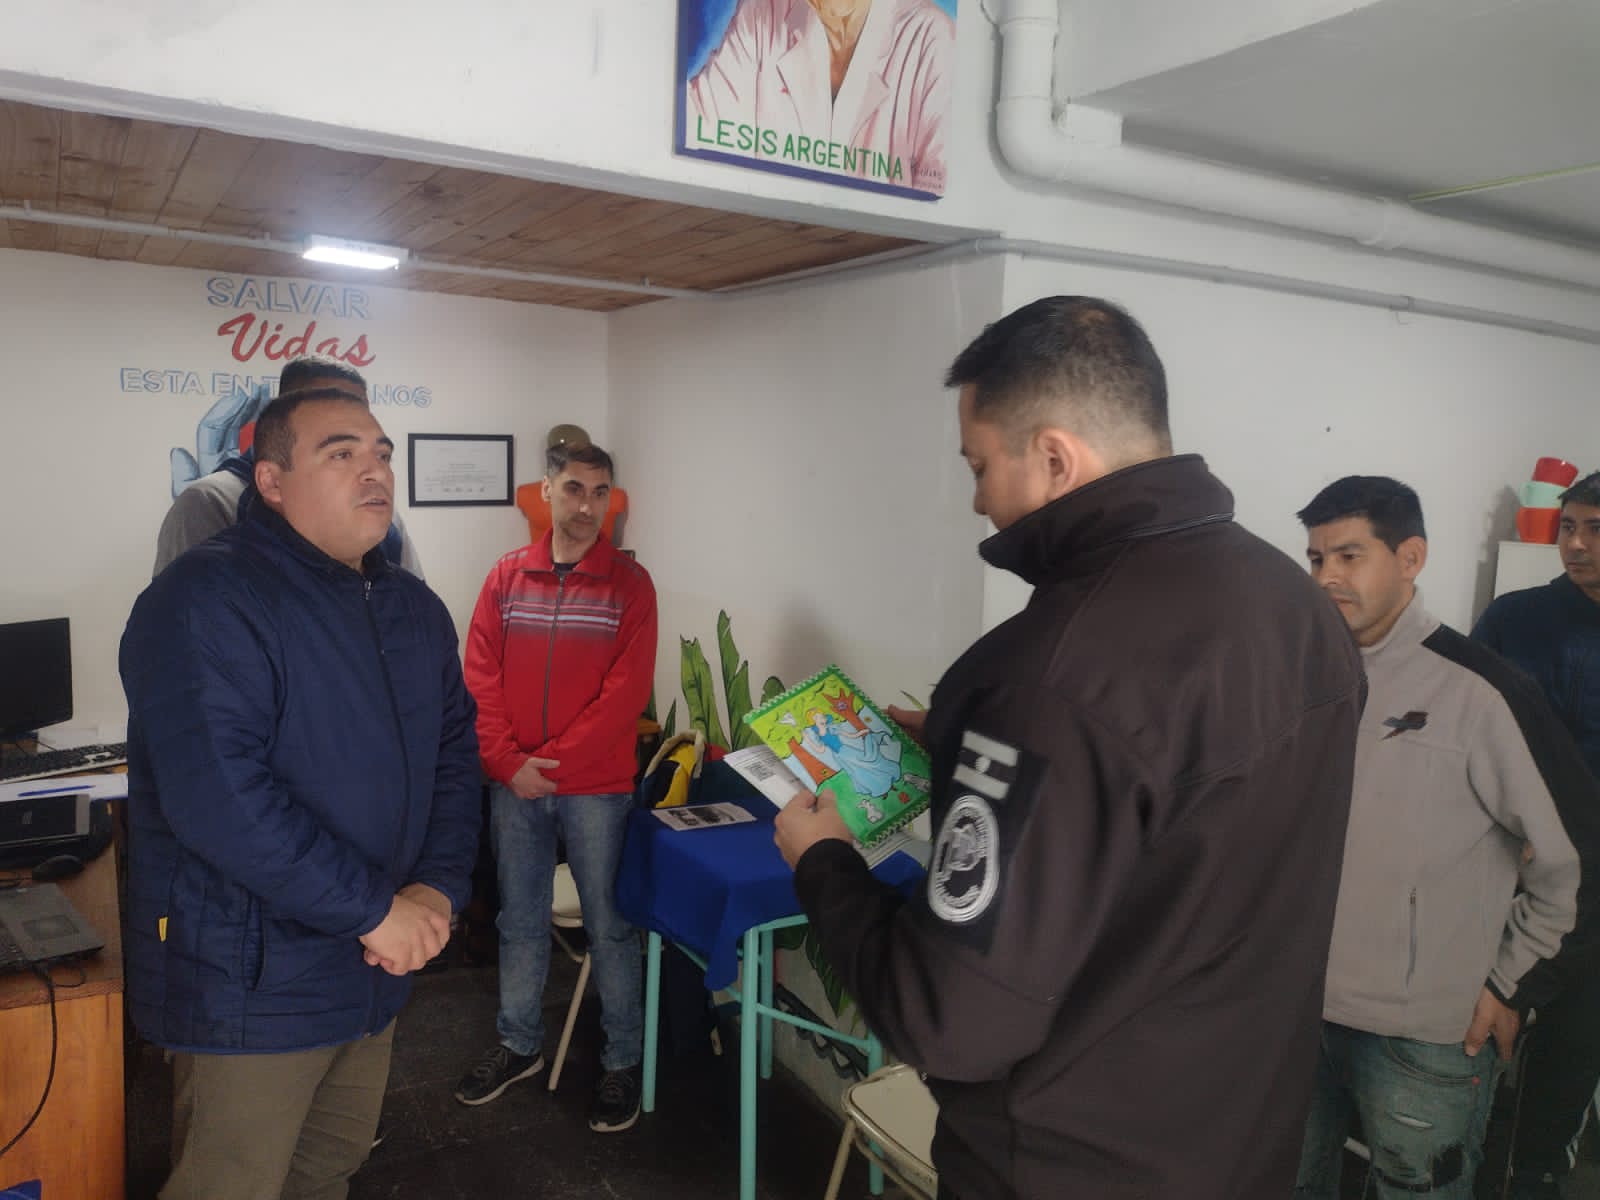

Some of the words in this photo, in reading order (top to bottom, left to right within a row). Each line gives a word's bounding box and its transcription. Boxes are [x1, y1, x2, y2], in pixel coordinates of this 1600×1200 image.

[697, 115, 777, 155] LESIS
[783, 133, 903, 180] ARGENTINA
[207, 277, 370, 318] SALVAR
[217, 312, 376, 366] Vidas
[120, 368, 204, 394] ESTA
[211, 373, 254, 398] EN
[370, 384, 432, 407] NOS
